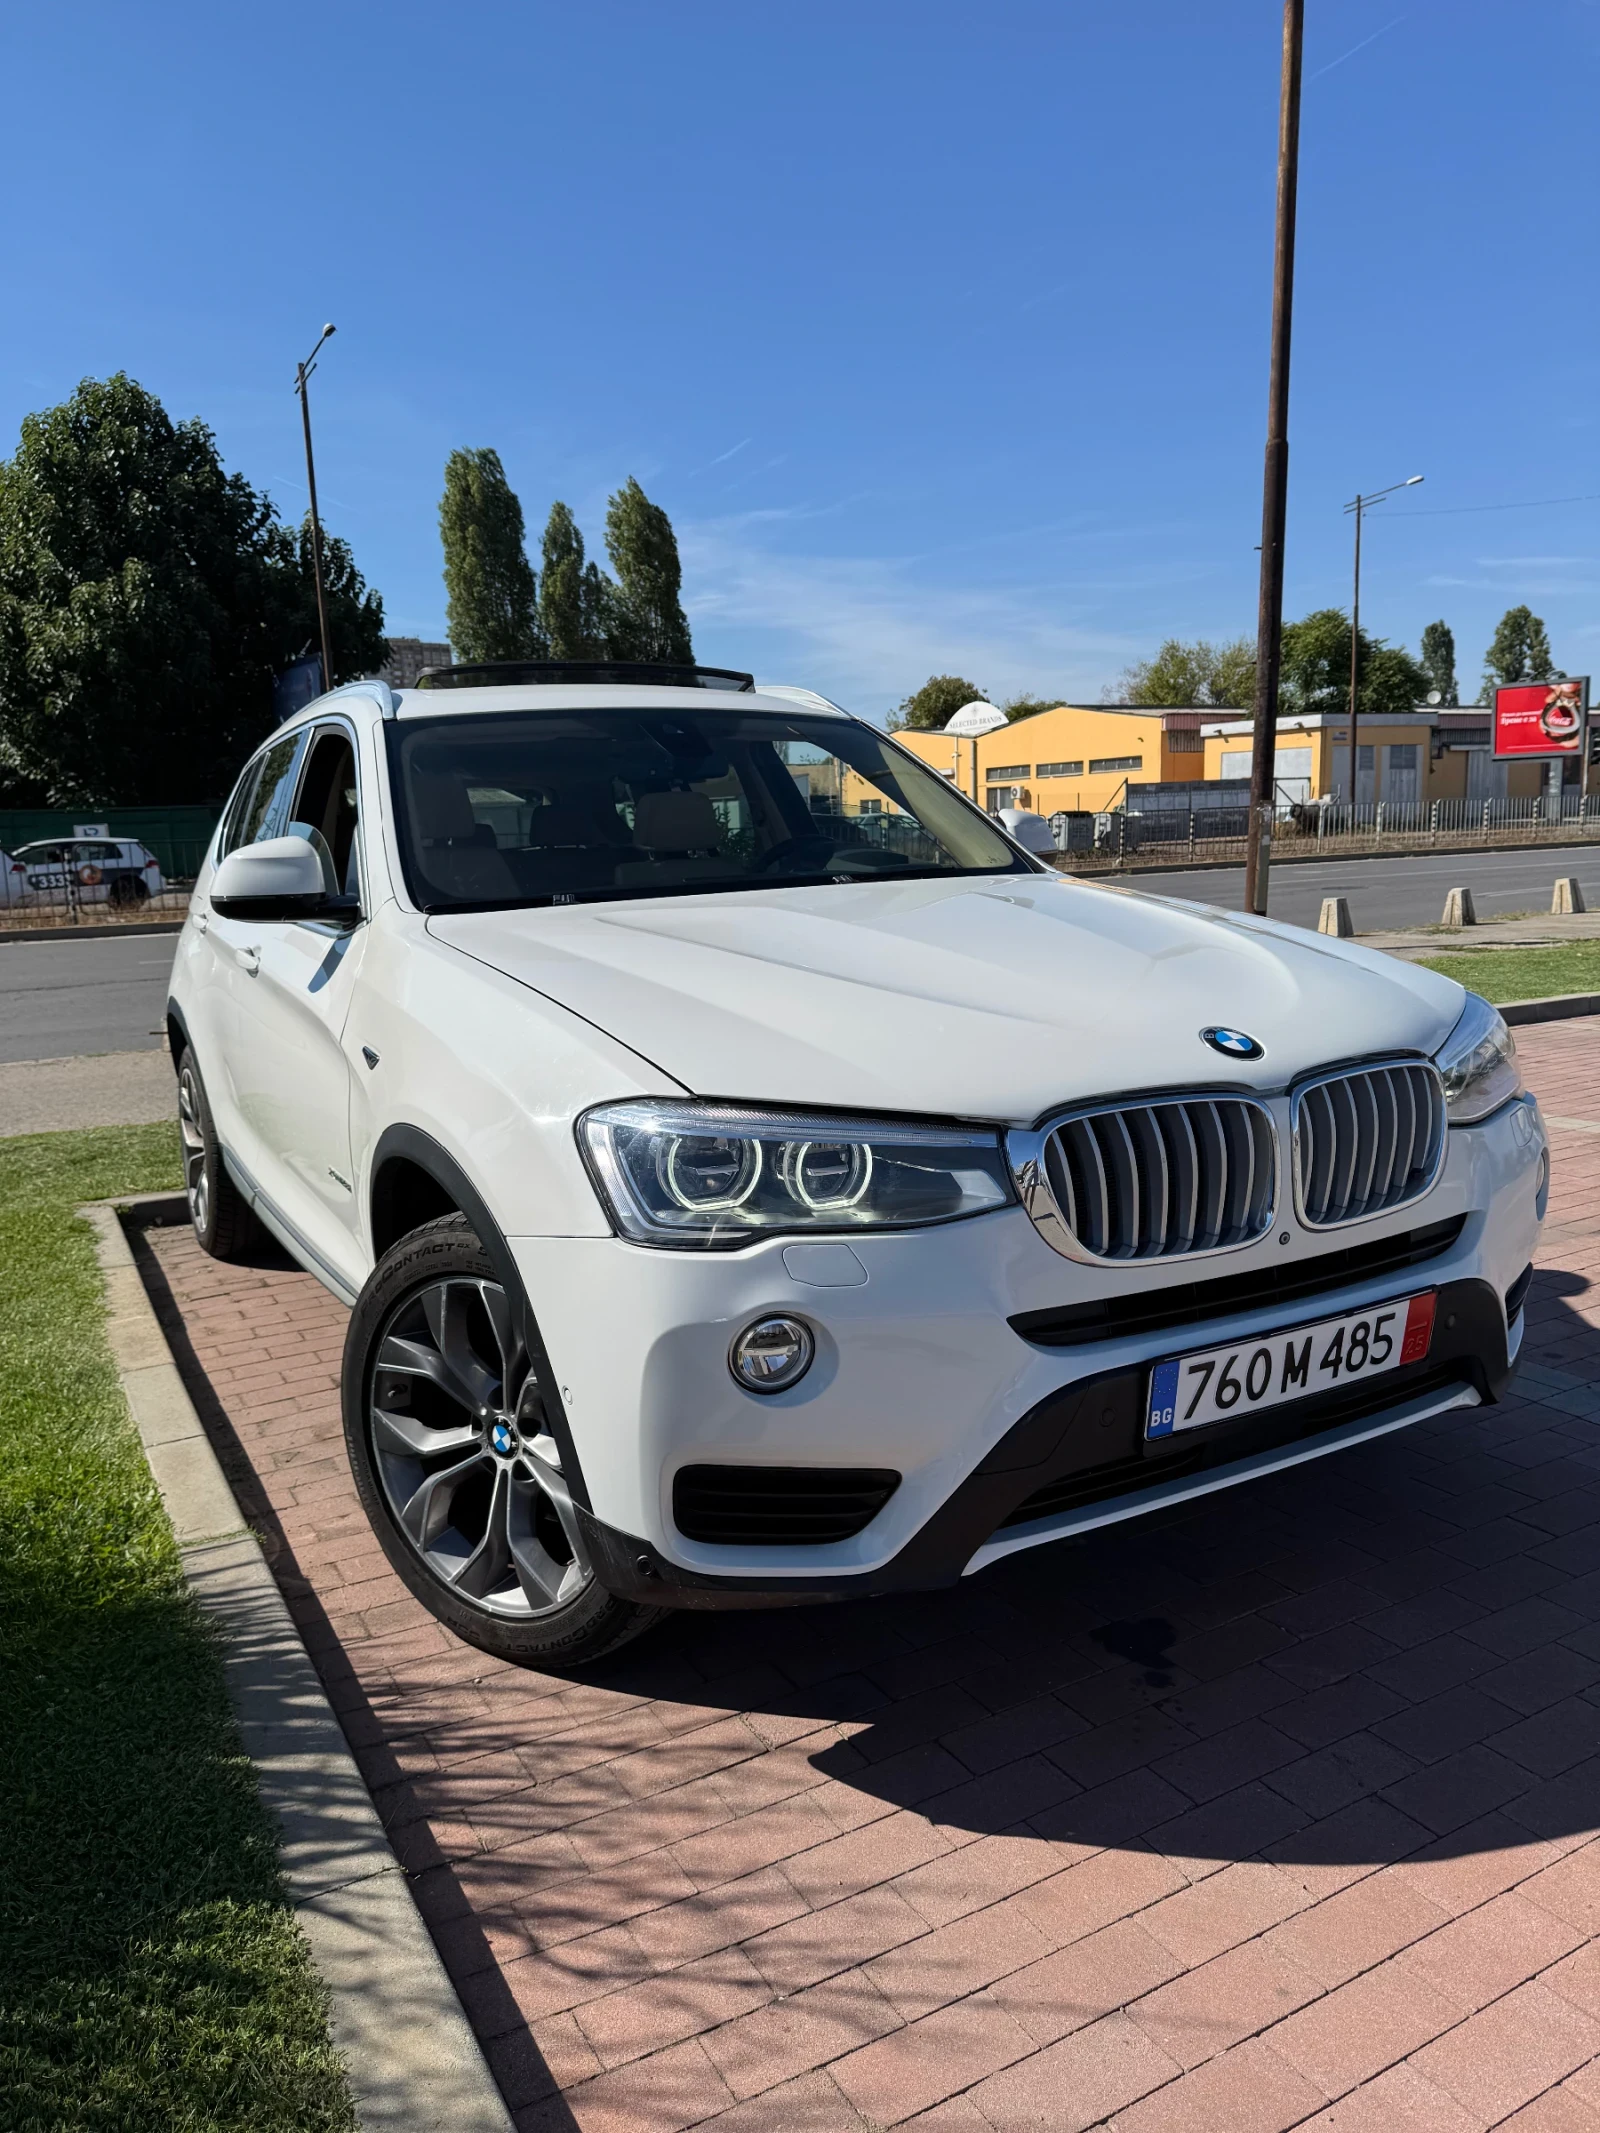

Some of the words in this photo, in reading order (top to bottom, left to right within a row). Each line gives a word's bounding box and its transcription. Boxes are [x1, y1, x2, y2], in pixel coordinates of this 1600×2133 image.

[949, 718, 978, 728] SELECTED
[979, 715, 1002, 725] BRANDS
[1183, 1347, 1273, 1420] 760
[1280, 1335, 1313, 1394] M
[1319, 1312, 1396, 1379] 485
[1150, 1407, 1172, 1428] BG
